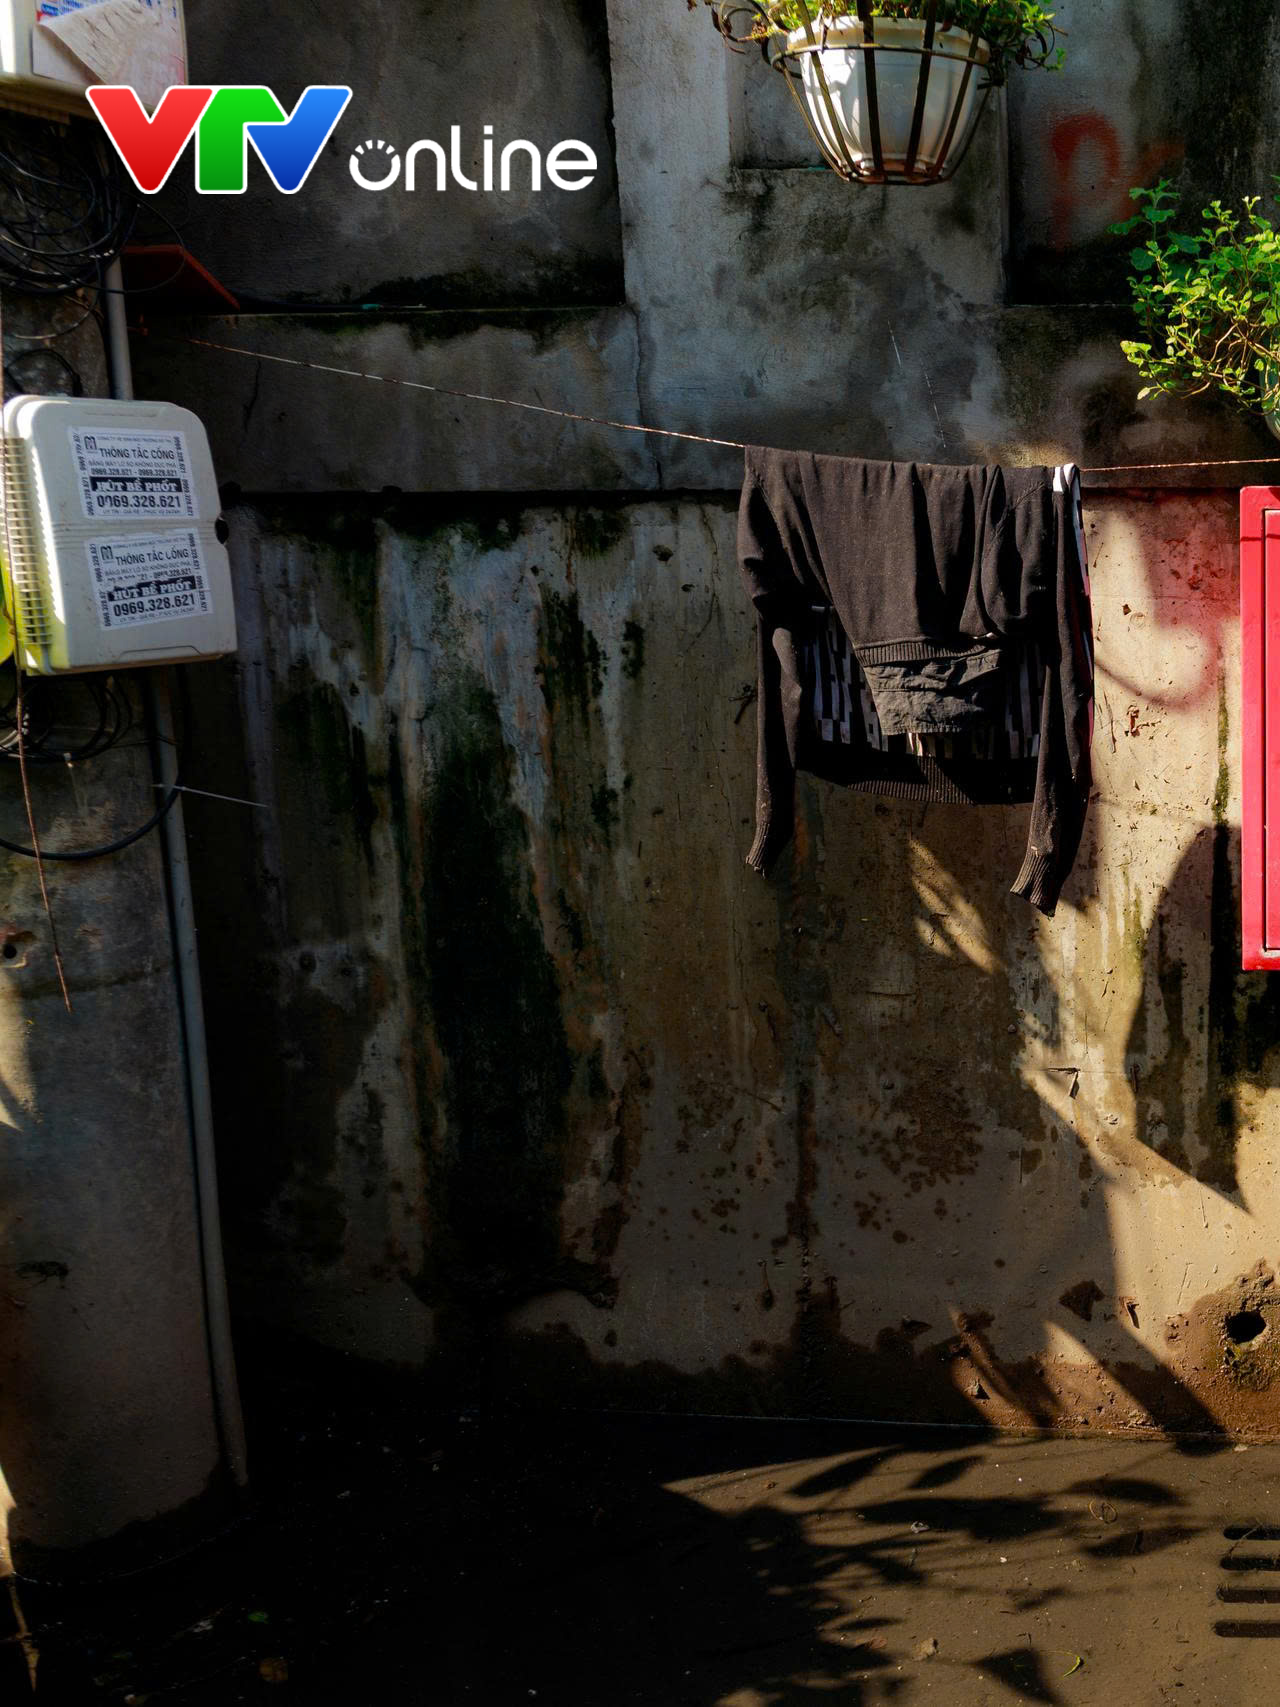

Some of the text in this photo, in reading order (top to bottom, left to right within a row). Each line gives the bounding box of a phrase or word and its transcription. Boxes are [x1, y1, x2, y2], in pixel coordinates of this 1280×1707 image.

[99, 445, 130, 458] THÔNG
[150, 446, 175, 460] CỐNG
[115, 552, 145, 566] THÔNG
[113, 593, 195, 617] 0969.328.621
